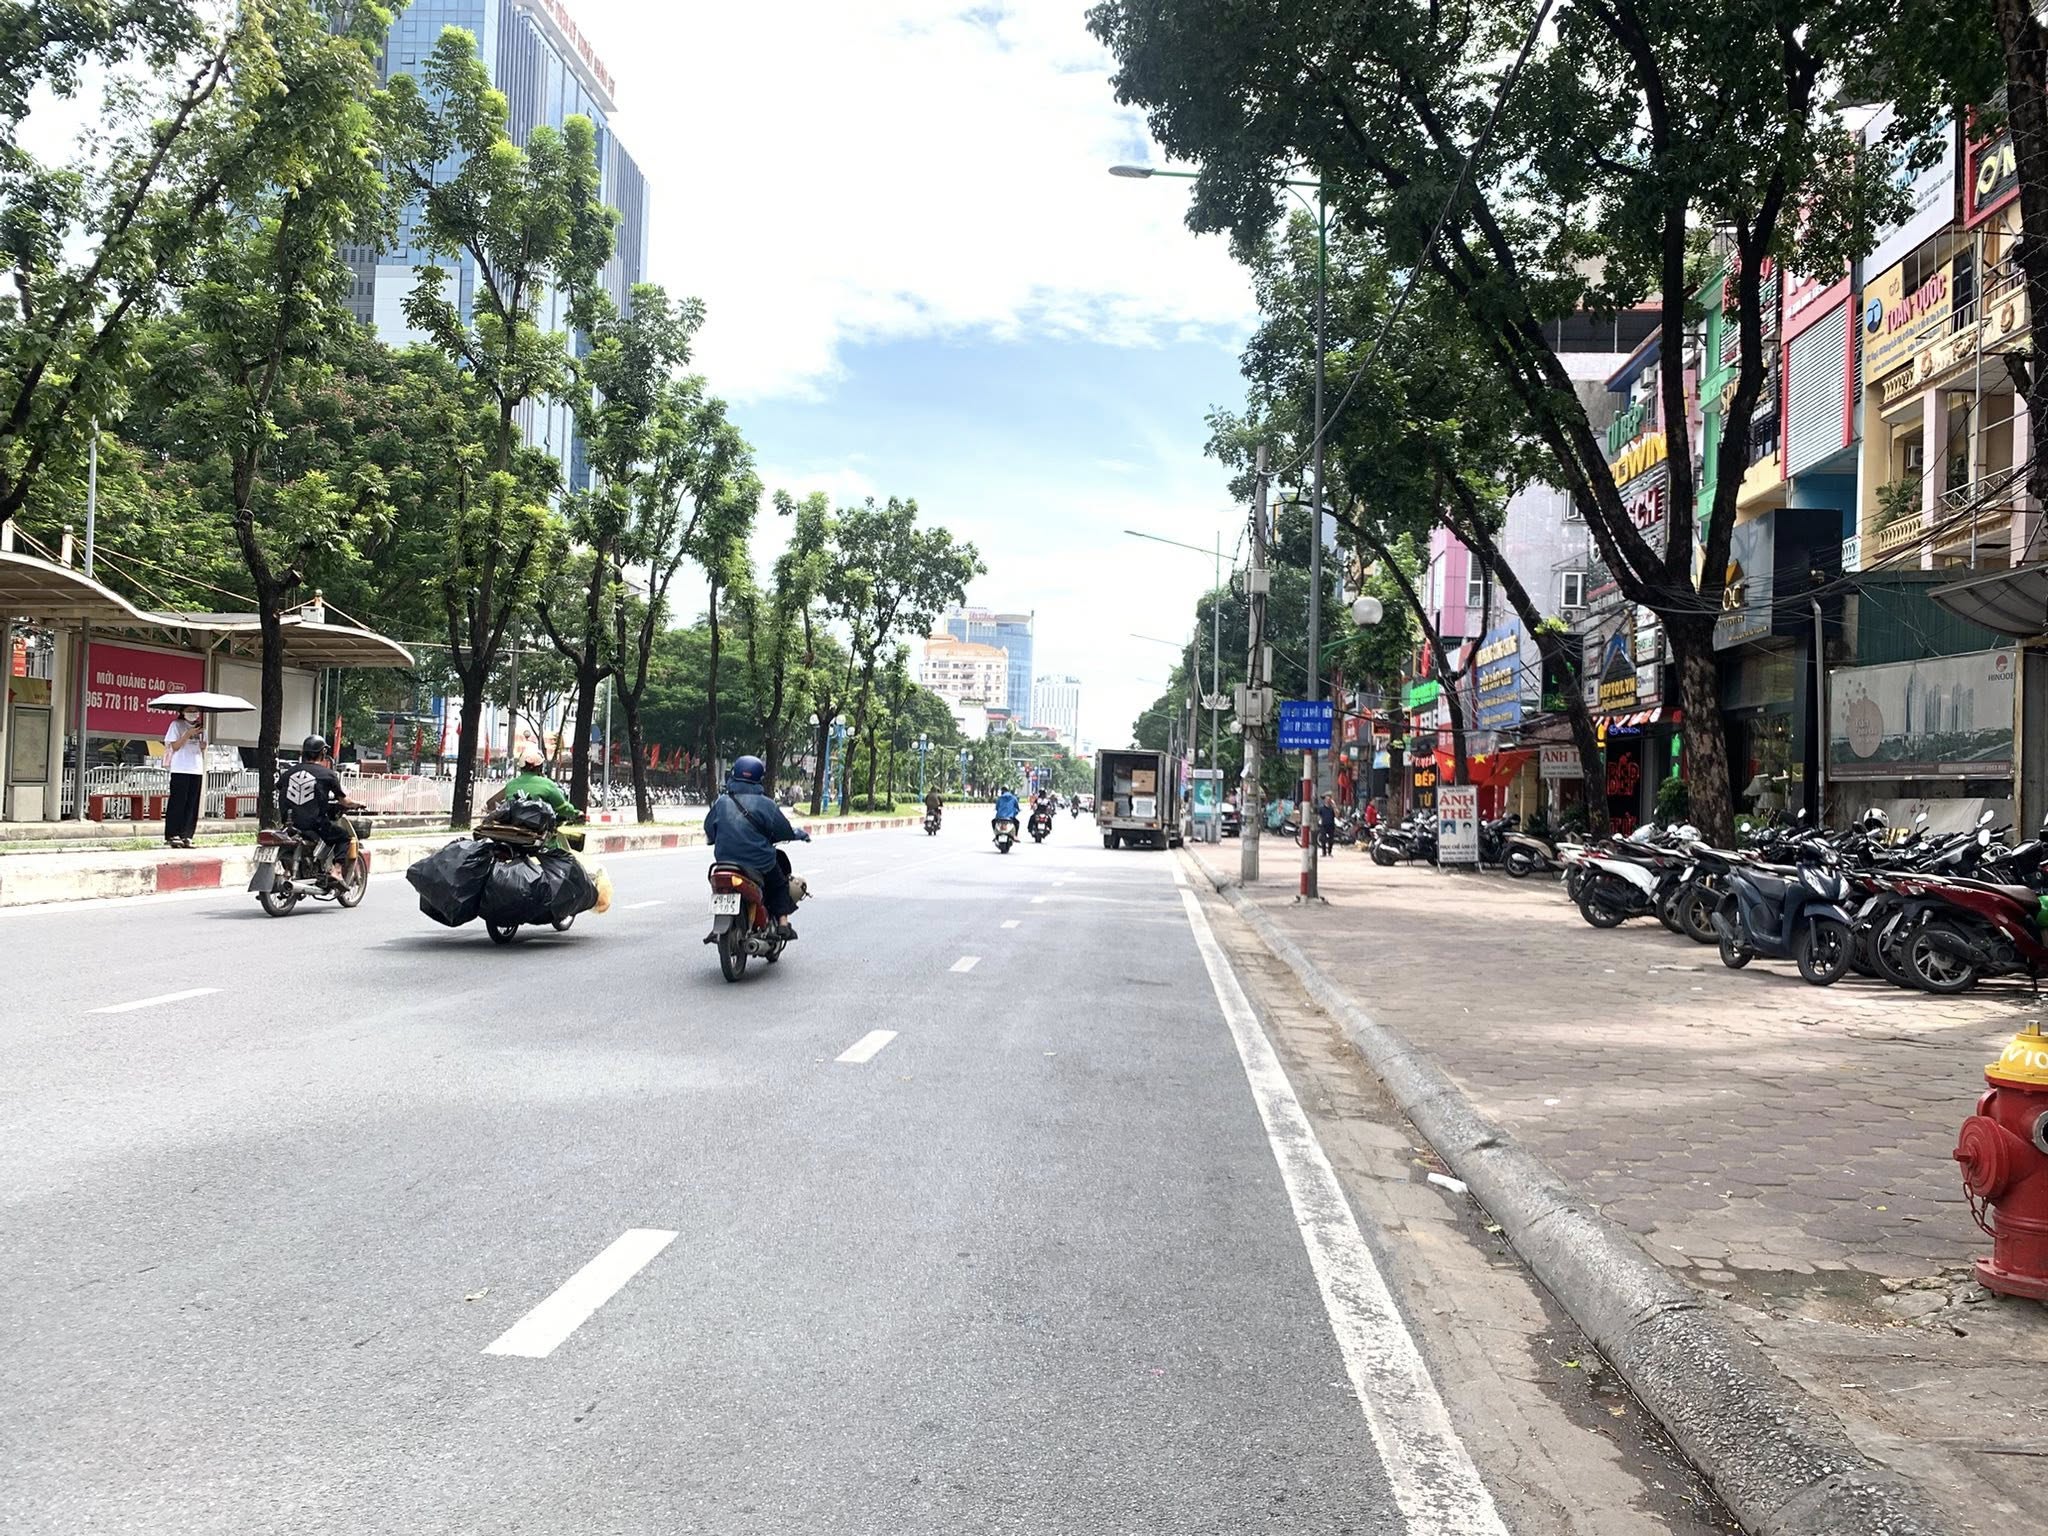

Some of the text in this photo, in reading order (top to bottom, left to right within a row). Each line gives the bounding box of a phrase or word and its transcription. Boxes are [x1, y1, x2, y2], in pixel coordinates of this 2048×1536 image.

[1620, 395, 1643, 447] BẾP
[116, 673, 146, 690] QUẢNG
[148, 676, 166, 692] CÁO
[105, 692, 121, 711] 778
[123, 695, 139, 712] 118
[1414, 768, 1436, 787] BẾP
